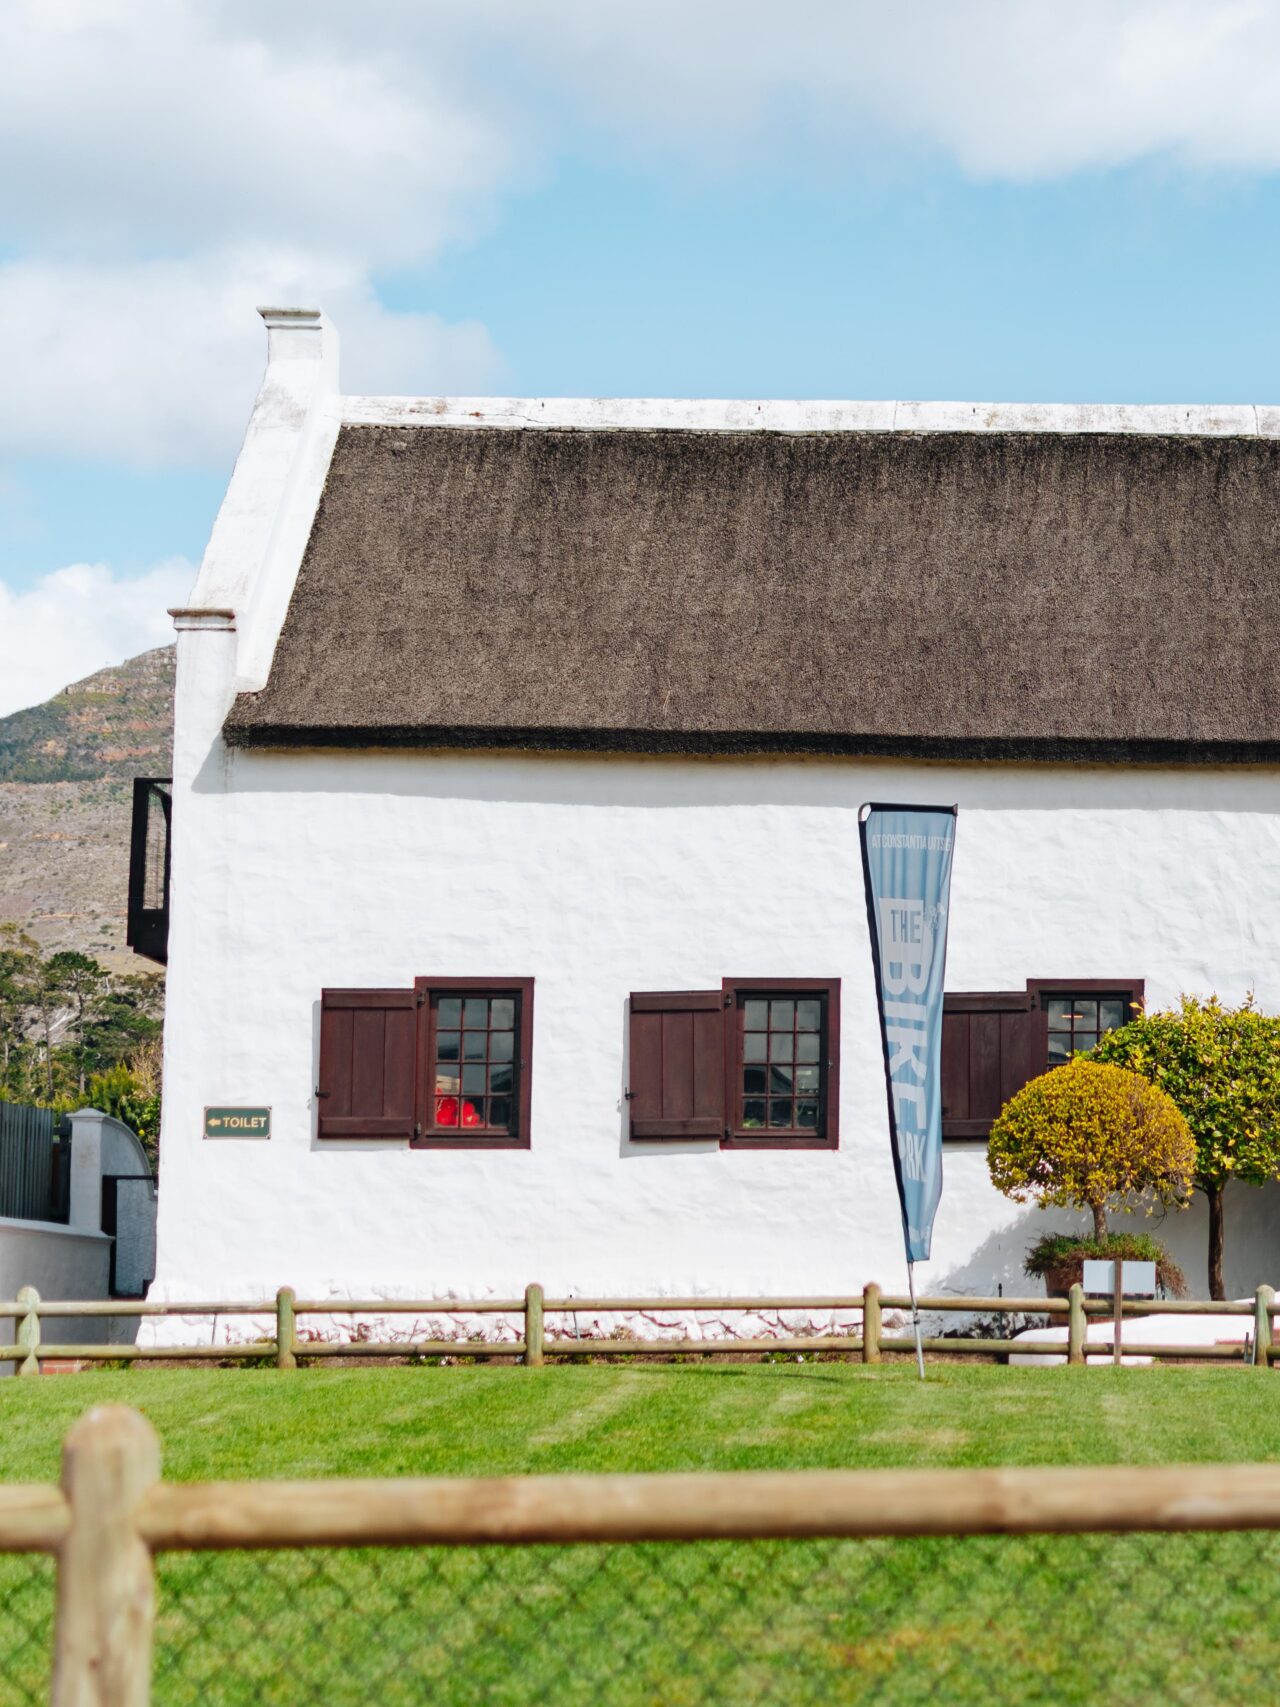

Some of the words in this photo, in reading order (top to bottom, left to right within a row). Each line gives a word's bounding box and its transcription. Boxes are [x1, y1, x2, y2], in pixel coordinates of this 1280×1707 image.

[872, 833, 881, 848] AT
[881, 833, 927, 849] CONSTANTIA
[890, 910, 921, 943] THE
[879, 898, 934, 1129] BIKE
[222, 1116, 267, 1128] TOILET
